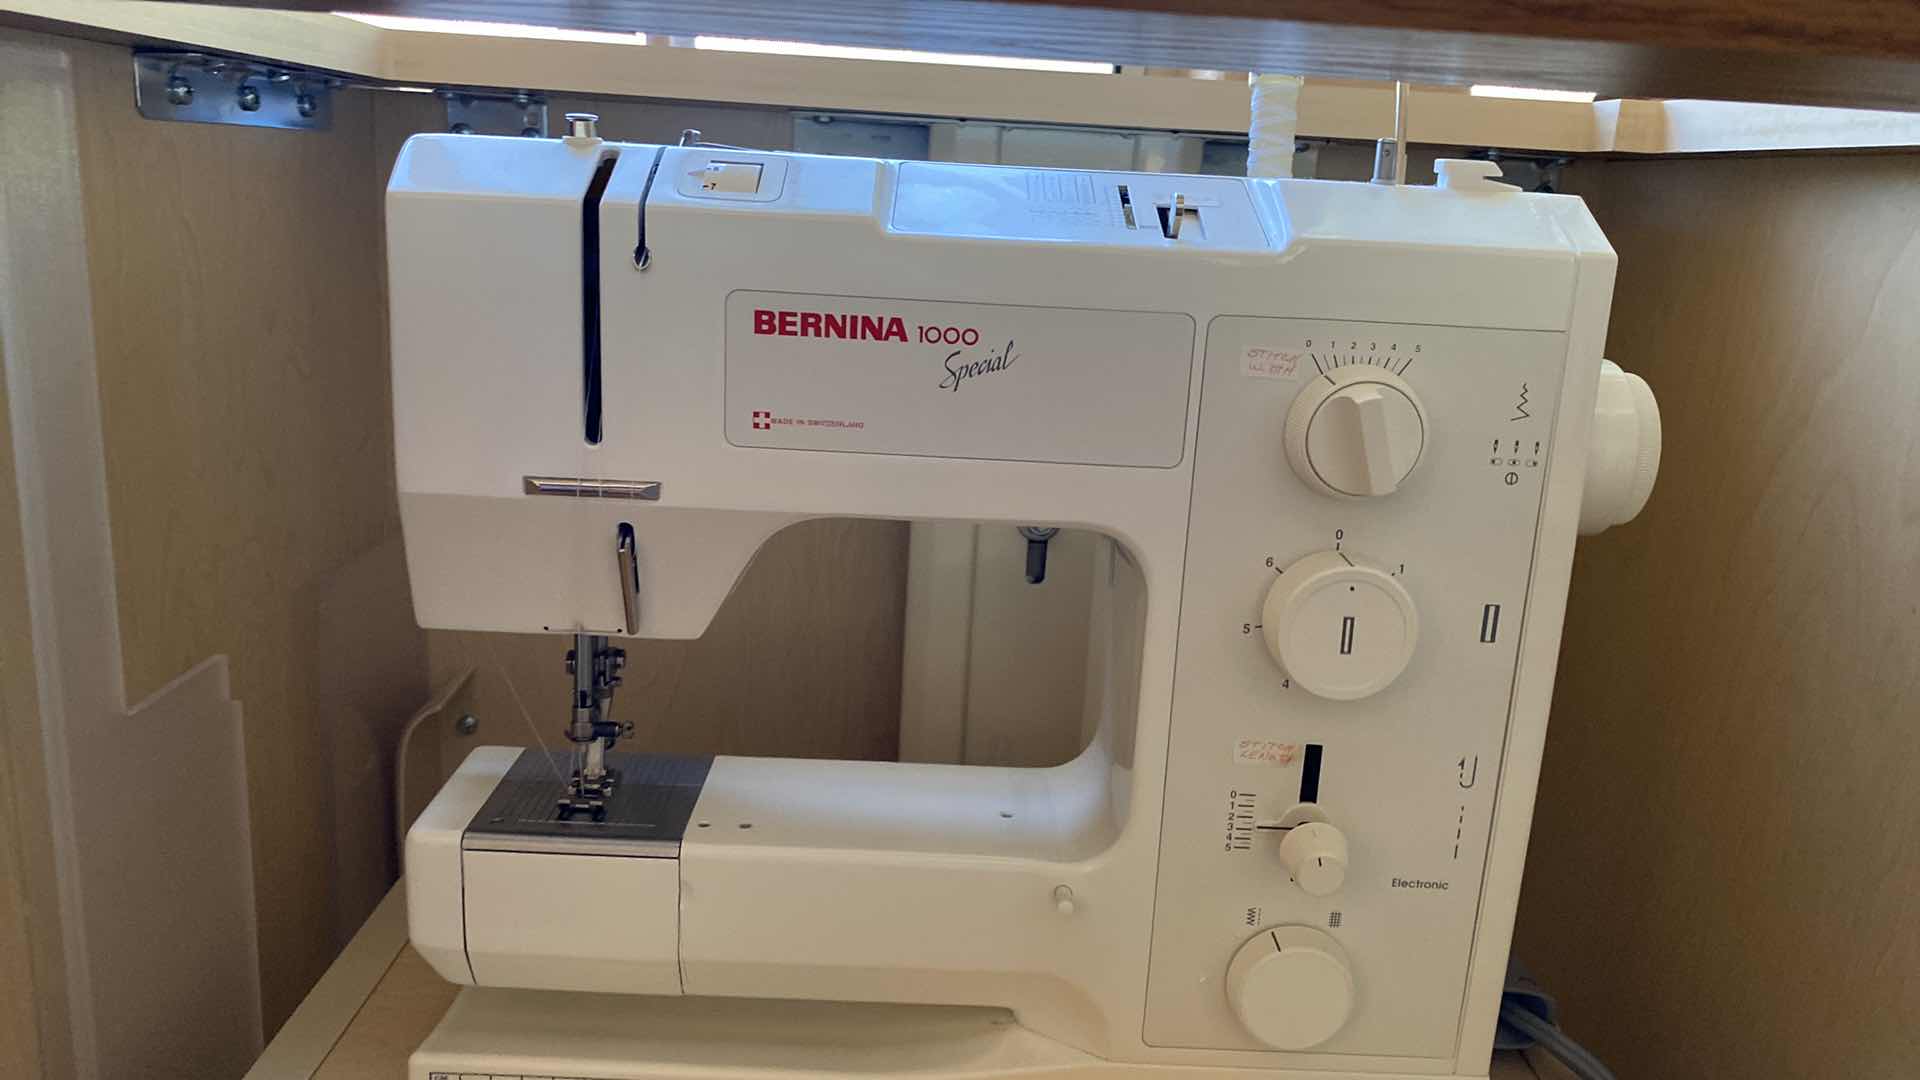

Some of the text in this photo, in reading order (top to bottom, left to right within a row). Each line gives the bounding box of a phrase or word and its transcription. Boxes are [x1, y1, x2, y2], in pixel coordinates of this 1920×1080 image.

[753, 308, 980, 346] BERNINA 1000
[1305, 339, 1421, 353] 0 1 2 3 4 5
[938, 339, 1023, 393] Special
[770, 417, 793, 425] MADE
[1335, 528, 1344, 541] 0
[1265, 556, 1274, 568] 6
[1399, 563, 1405, 574] 1
[1242, 622, 1251, 635] 5
[1281, 678, 1290, 690] 4
[1230, 790, 1237, 799] 0
[1230, 801, 1235, 810] 1
[1228, 812, 1235, 821] 2
[1227, 822, 1234, 831] 3
[1225, 832, 1232, 841] 4
[1224, 843, 1232, 852] 5
[1391, 877, 1449, 890] Electronic
